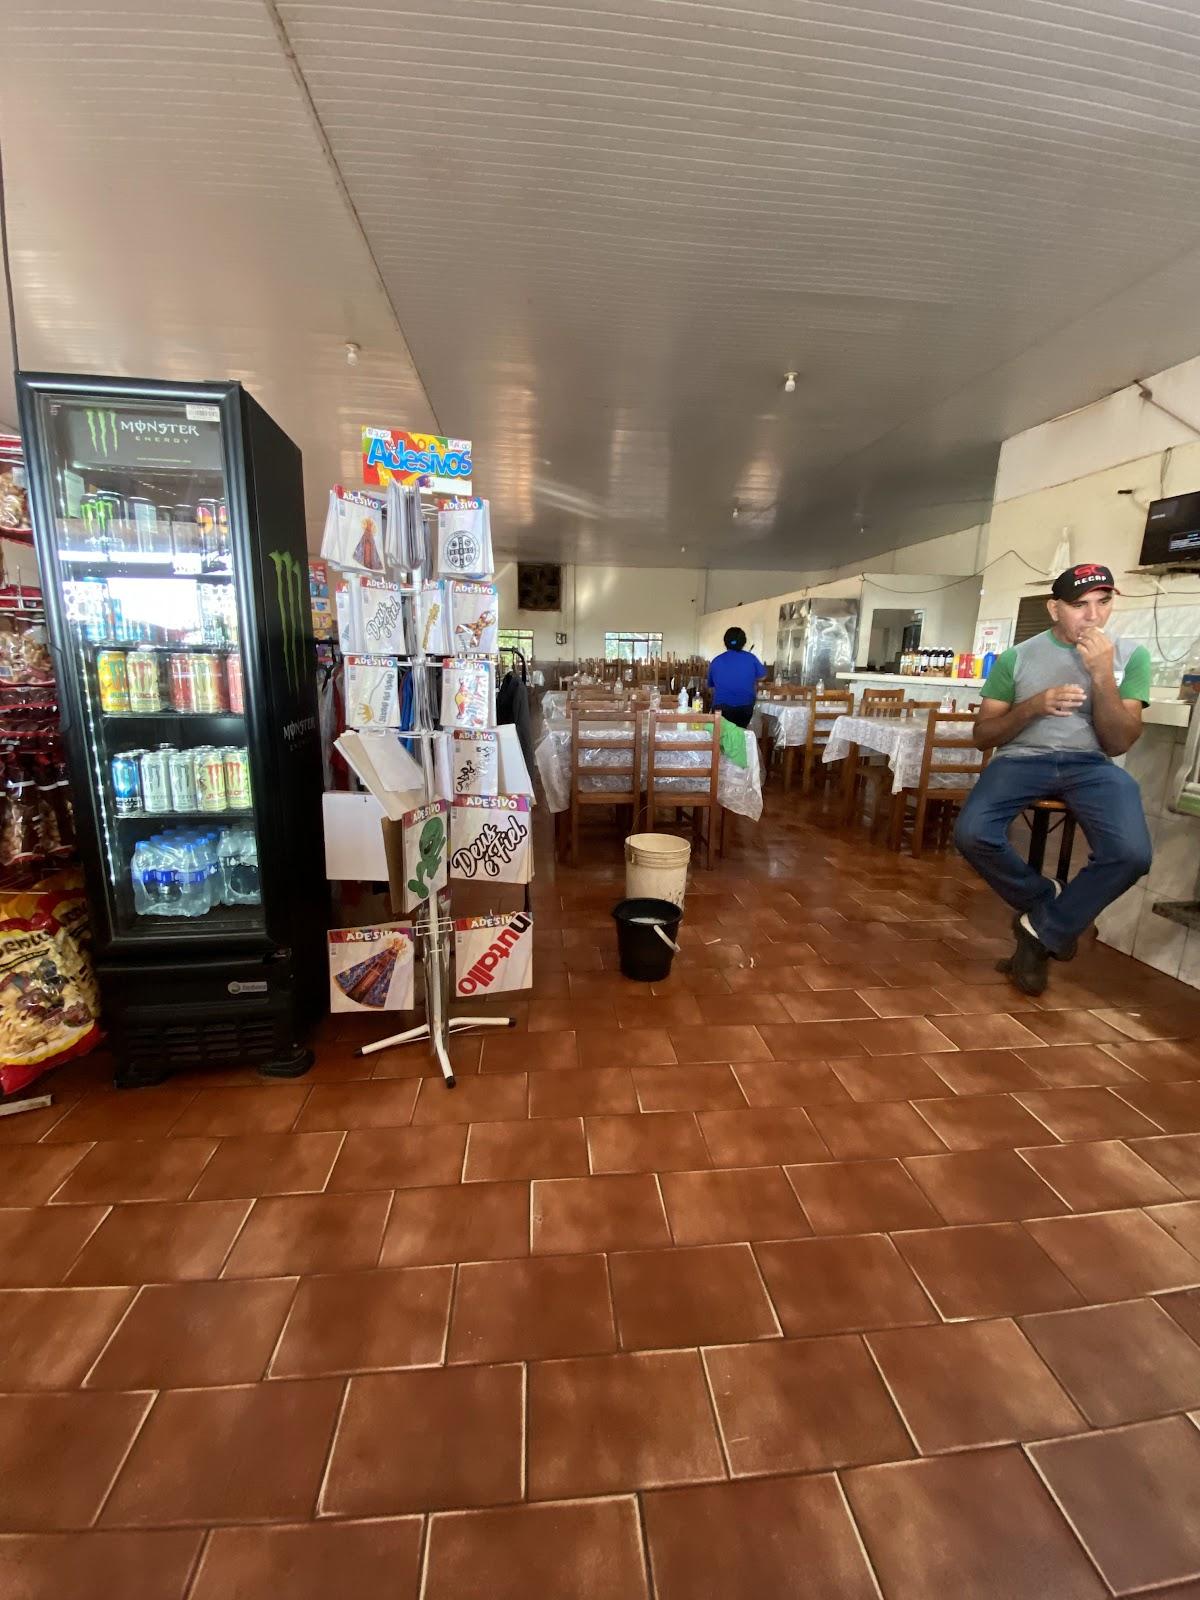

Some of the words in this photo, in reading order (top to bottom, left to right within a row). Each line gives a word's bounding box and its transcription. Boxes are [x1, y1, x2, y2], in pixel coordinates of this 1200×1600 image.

[120, 420, 200, 436] MONSTER
[135, 435, 190, 444] ENERGY
[366, 438, 473, 477] Adesivos
[343, 492, 379, 509] ADESIVO
[443, 501, 479, 510] ADESIVO
[366, 580, 399, 591] ADESIVO
[455, 584, 494, 595] ADESIVO
[354, 657, 394, 667] ADESIVO
[466, 797, 518, 810] ADESIVO
[413, 803, 441, 822] ADESIVO
[452, 823, 498, 878] Deus
[487, 815, 528, 863] Fiel
[471, 914, 514, 928] ADESIV
[346, 930, 396, 941] ADESIV
[458, 914, 532, 994] nutallo
